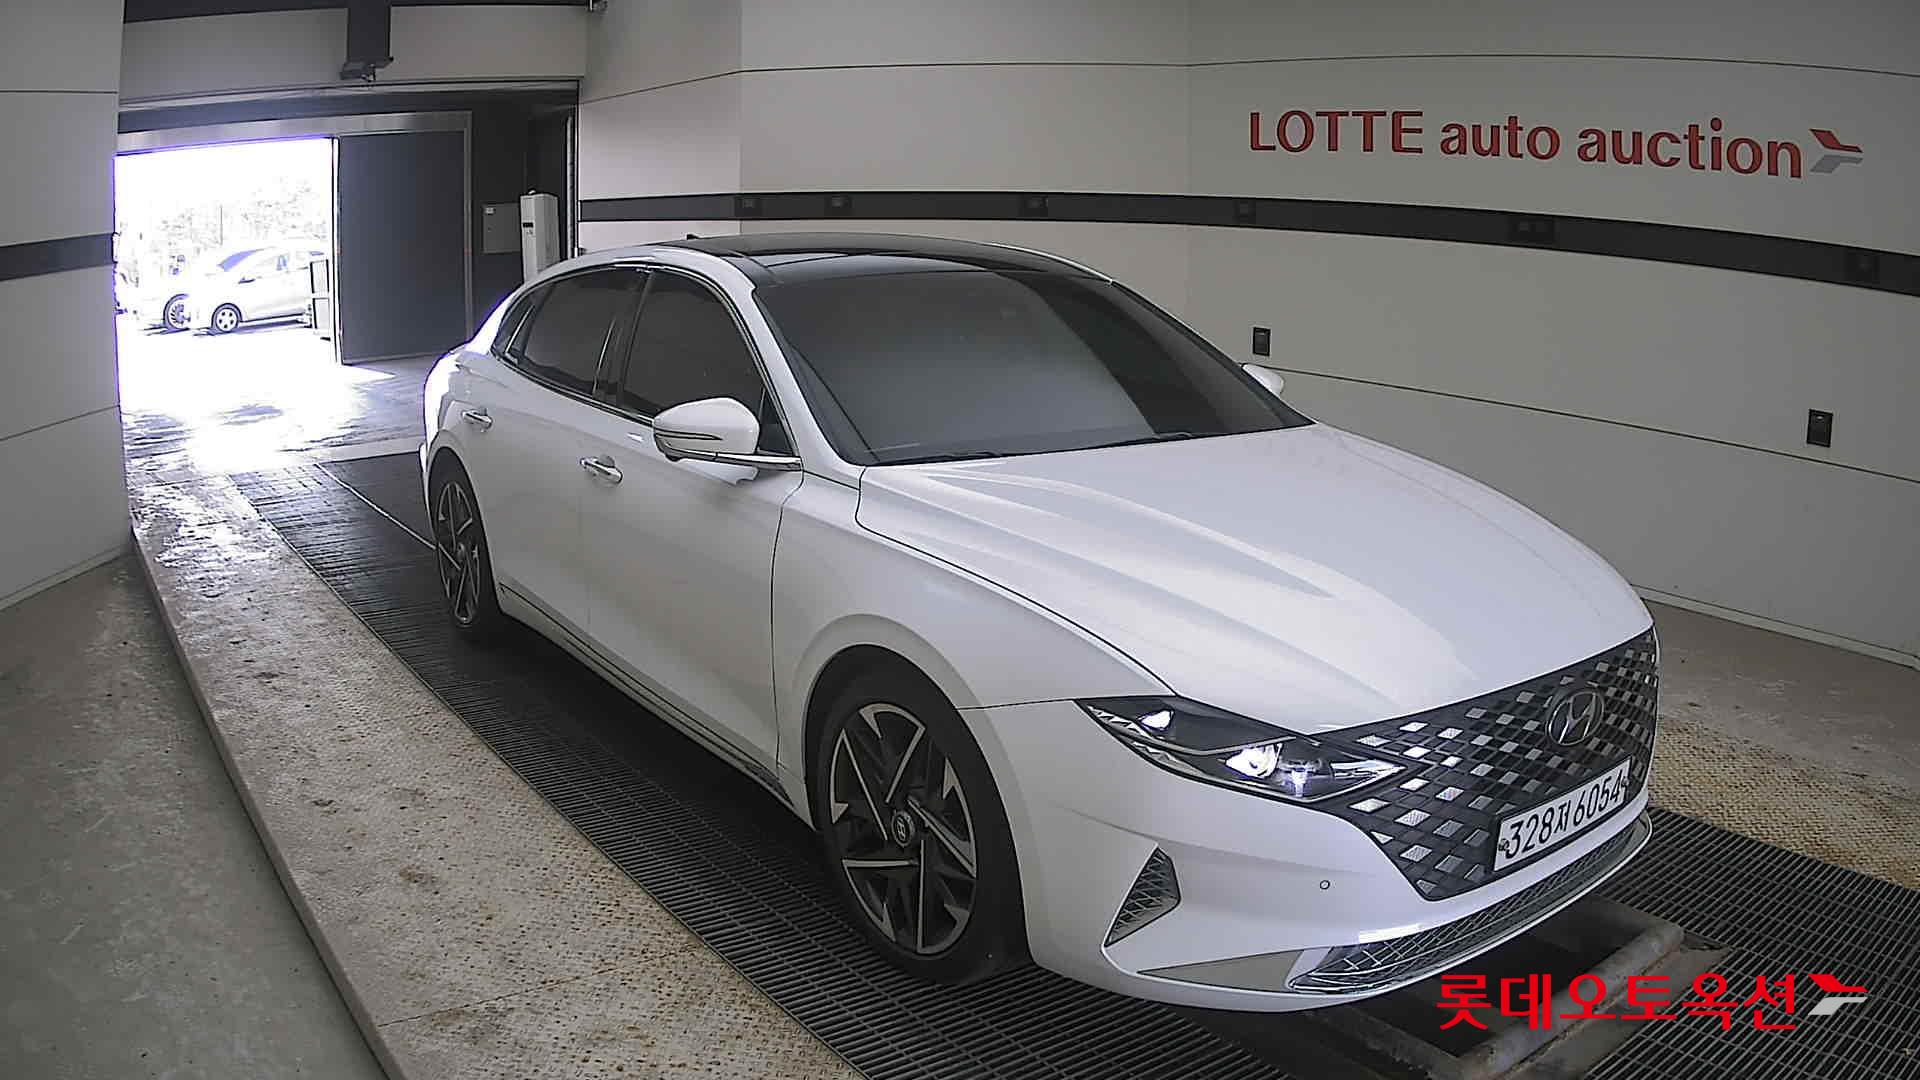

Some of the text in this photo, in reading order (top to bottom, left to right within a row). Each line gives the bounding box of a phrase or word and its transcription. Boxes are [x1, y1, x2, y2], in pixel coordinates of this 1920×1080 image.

[1250, 110, 1803, 178] LOTTE auto auction
